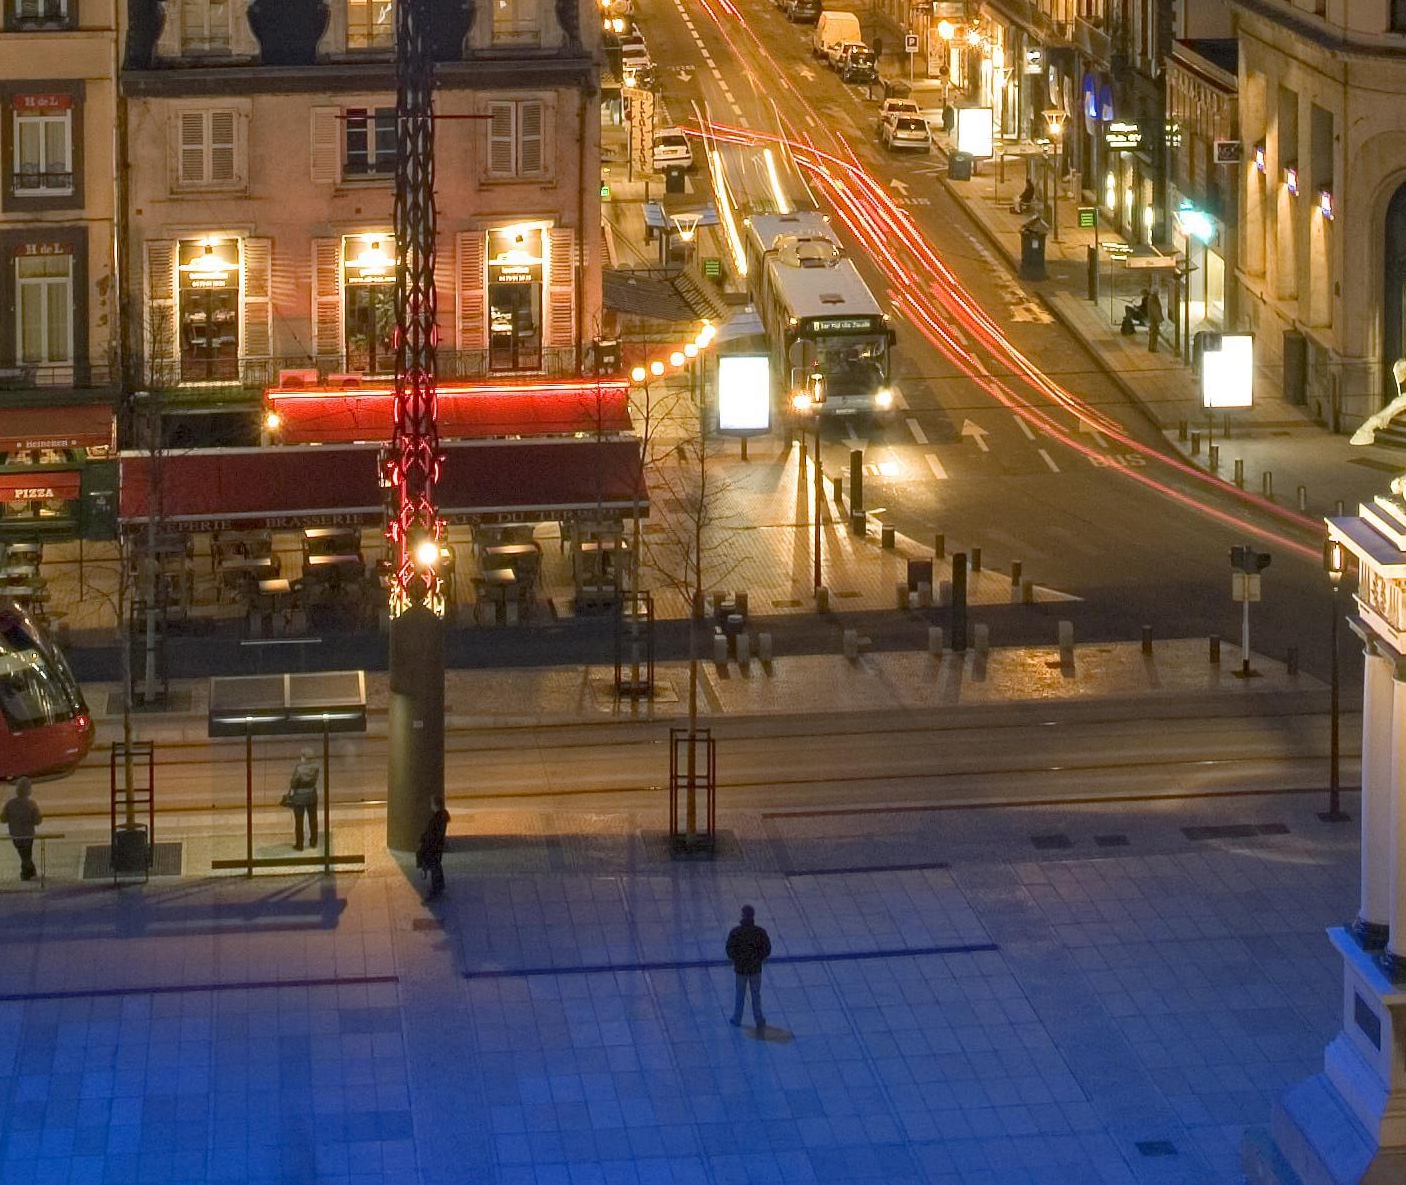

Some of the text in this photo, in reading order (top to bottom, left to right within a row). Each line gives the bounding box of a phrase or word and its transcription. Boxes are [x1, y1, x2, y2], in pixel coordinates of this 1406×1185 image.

[25, 98, 35, 106] H
[26, 244, 37, 254] H
[15, 487, 54, 499] PIZZA
[266, 513, 364, 528] BRASSERIE
[497, 512, 524, 523] DU
